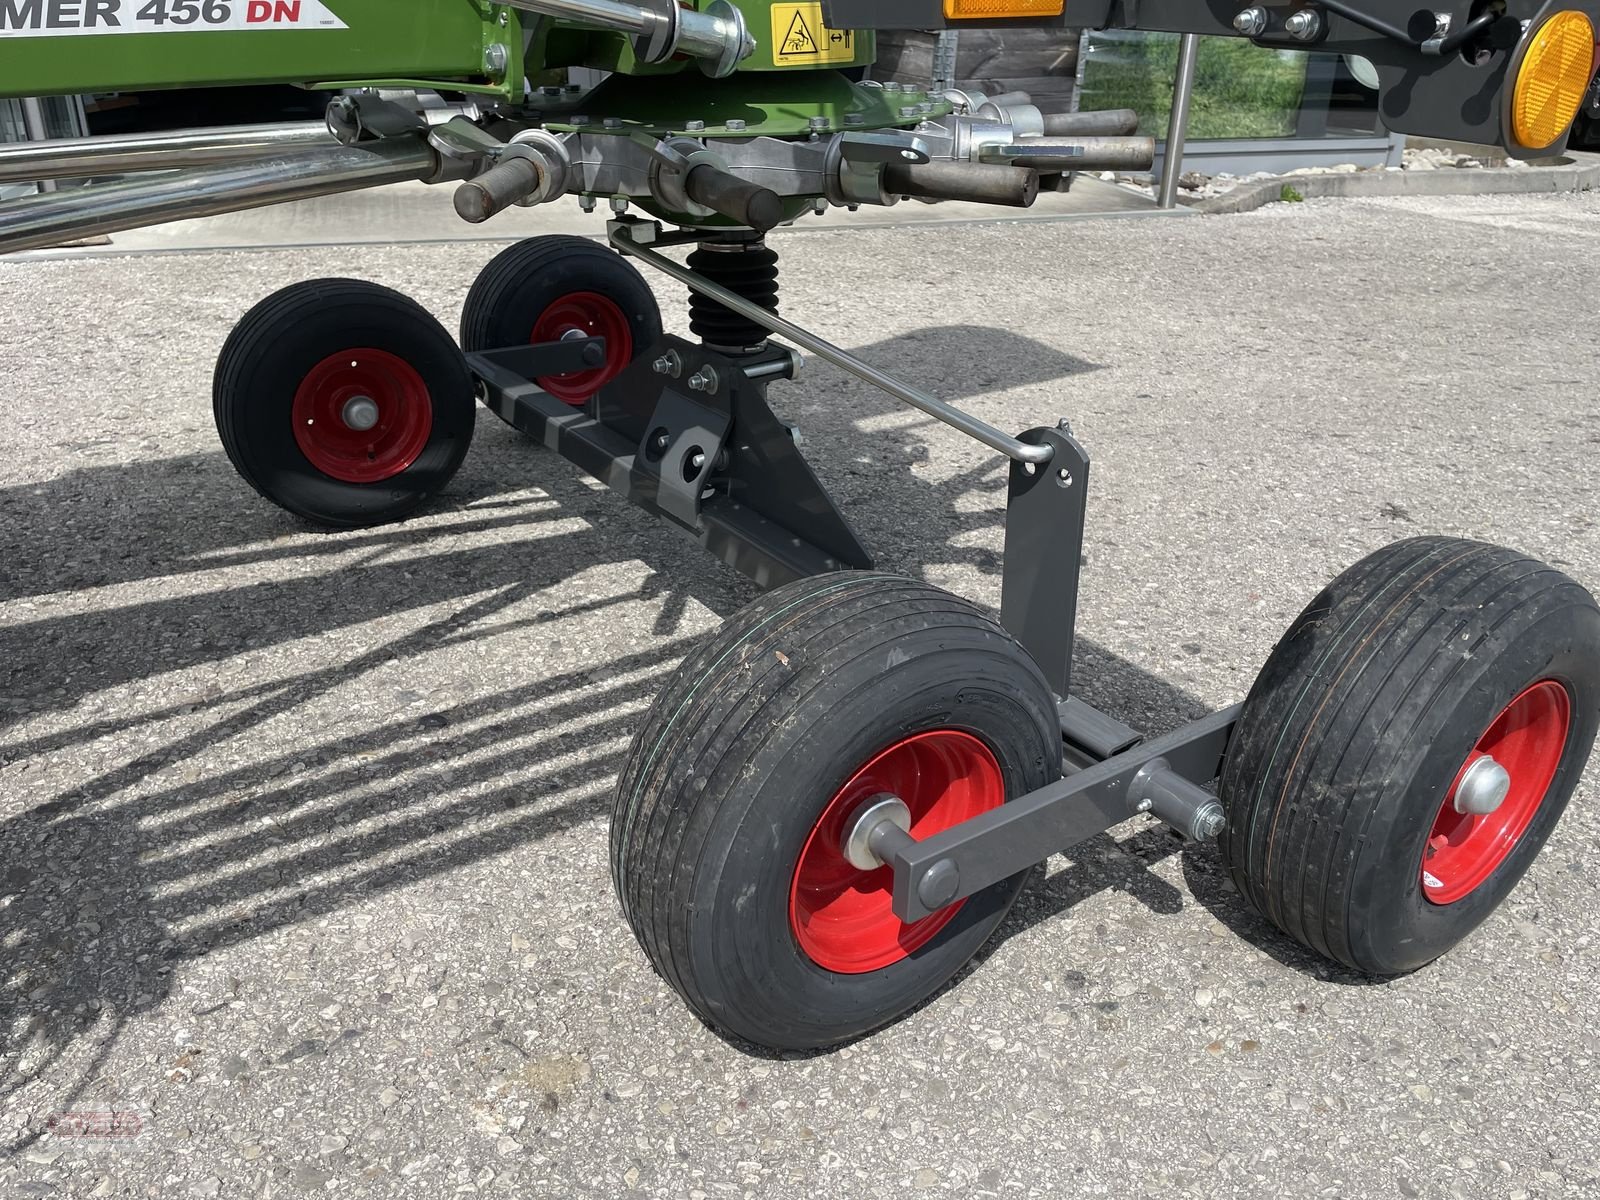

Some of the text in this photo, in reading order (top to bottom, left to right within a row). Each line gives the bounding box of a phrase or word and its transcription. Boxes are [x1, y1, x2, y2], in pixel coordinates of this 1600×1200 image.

[0, 0, 300, 29] MER 456 DN
